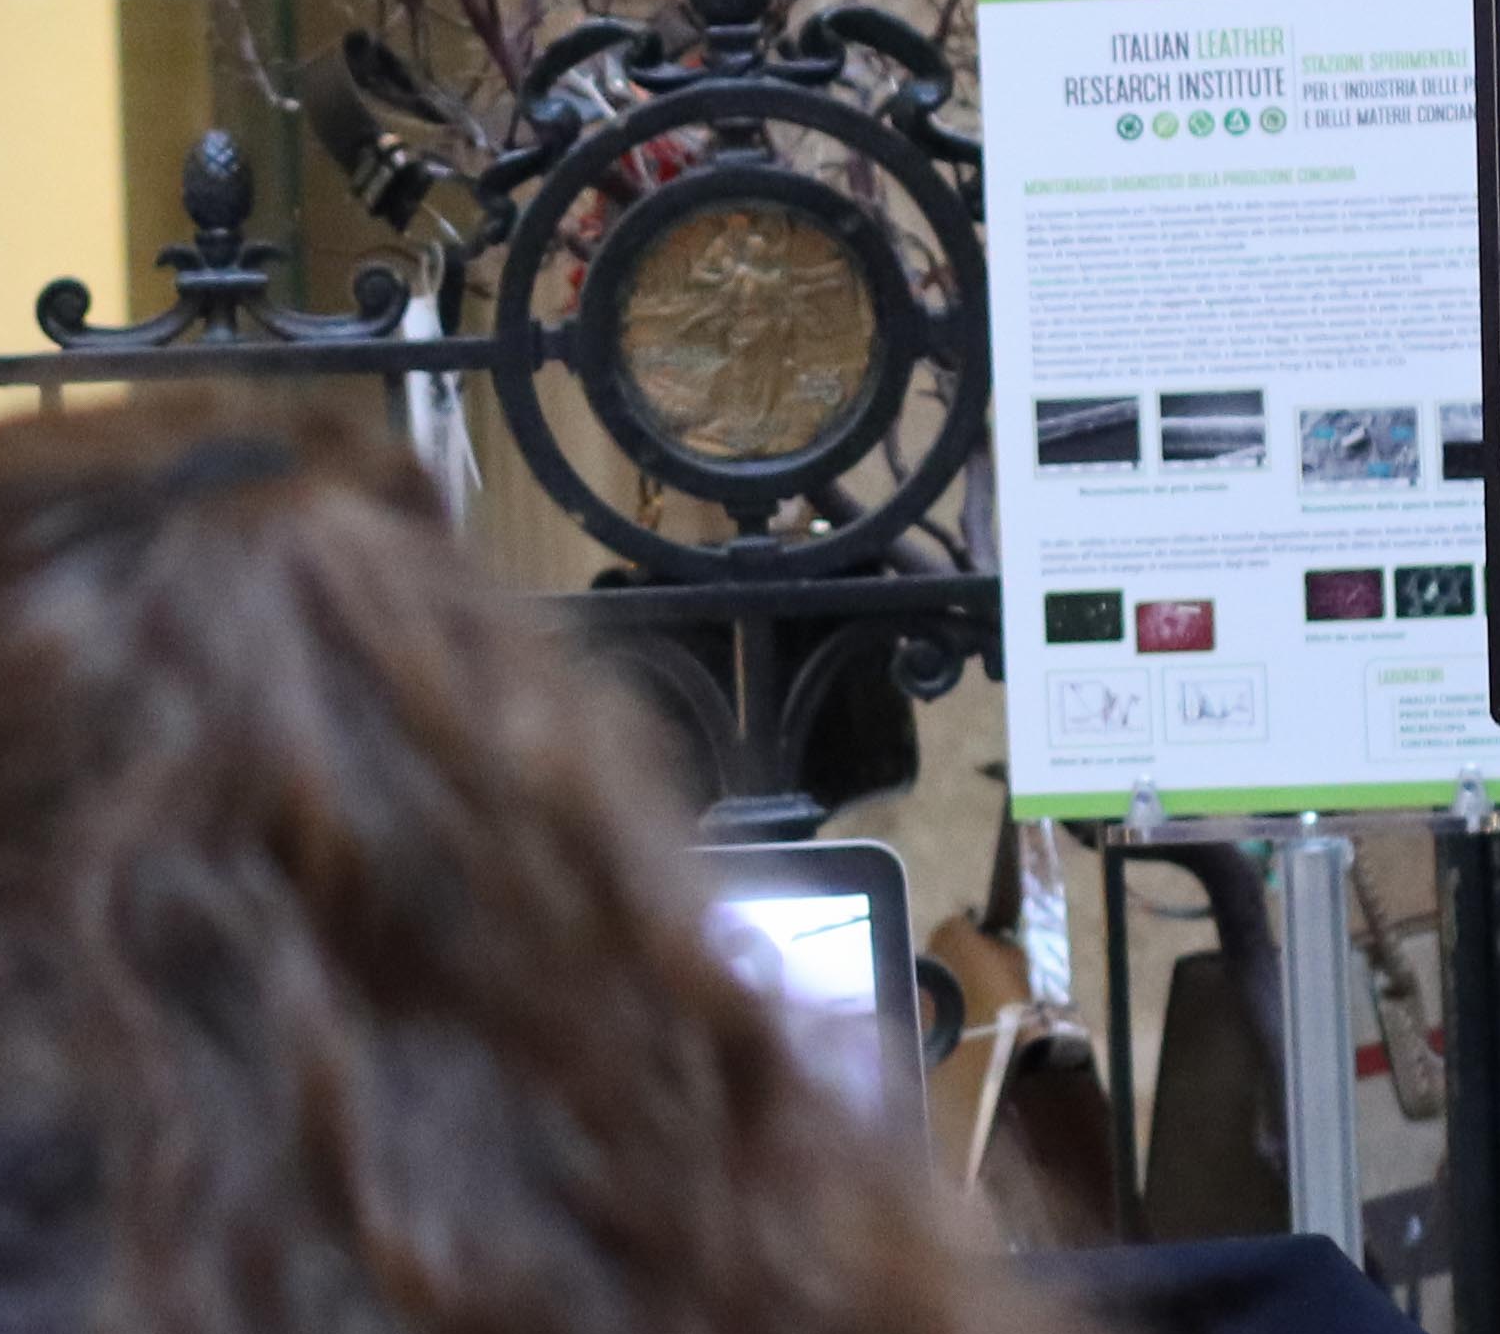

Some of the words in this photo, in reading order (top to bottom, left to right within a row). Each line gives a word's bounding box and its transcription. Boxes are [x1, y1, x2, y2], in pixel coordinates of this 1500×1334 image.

[1112, 31, 1190, 63] ITALIAN
[1197, 26, 1285, 60] LEATHER
[1302, 53, 1364, 74] STAZIONE
[1065, 71, 1171, 107] RESEARCH
[1178, 66, 1286, 101] INSTITUTE
[1303, 82, 1329, 102] PER
[1463, 74, 1475, 94] P
[1315, 106, 1351, 129] DELLE
[1357, 103, 1413, 127] MATERIE
